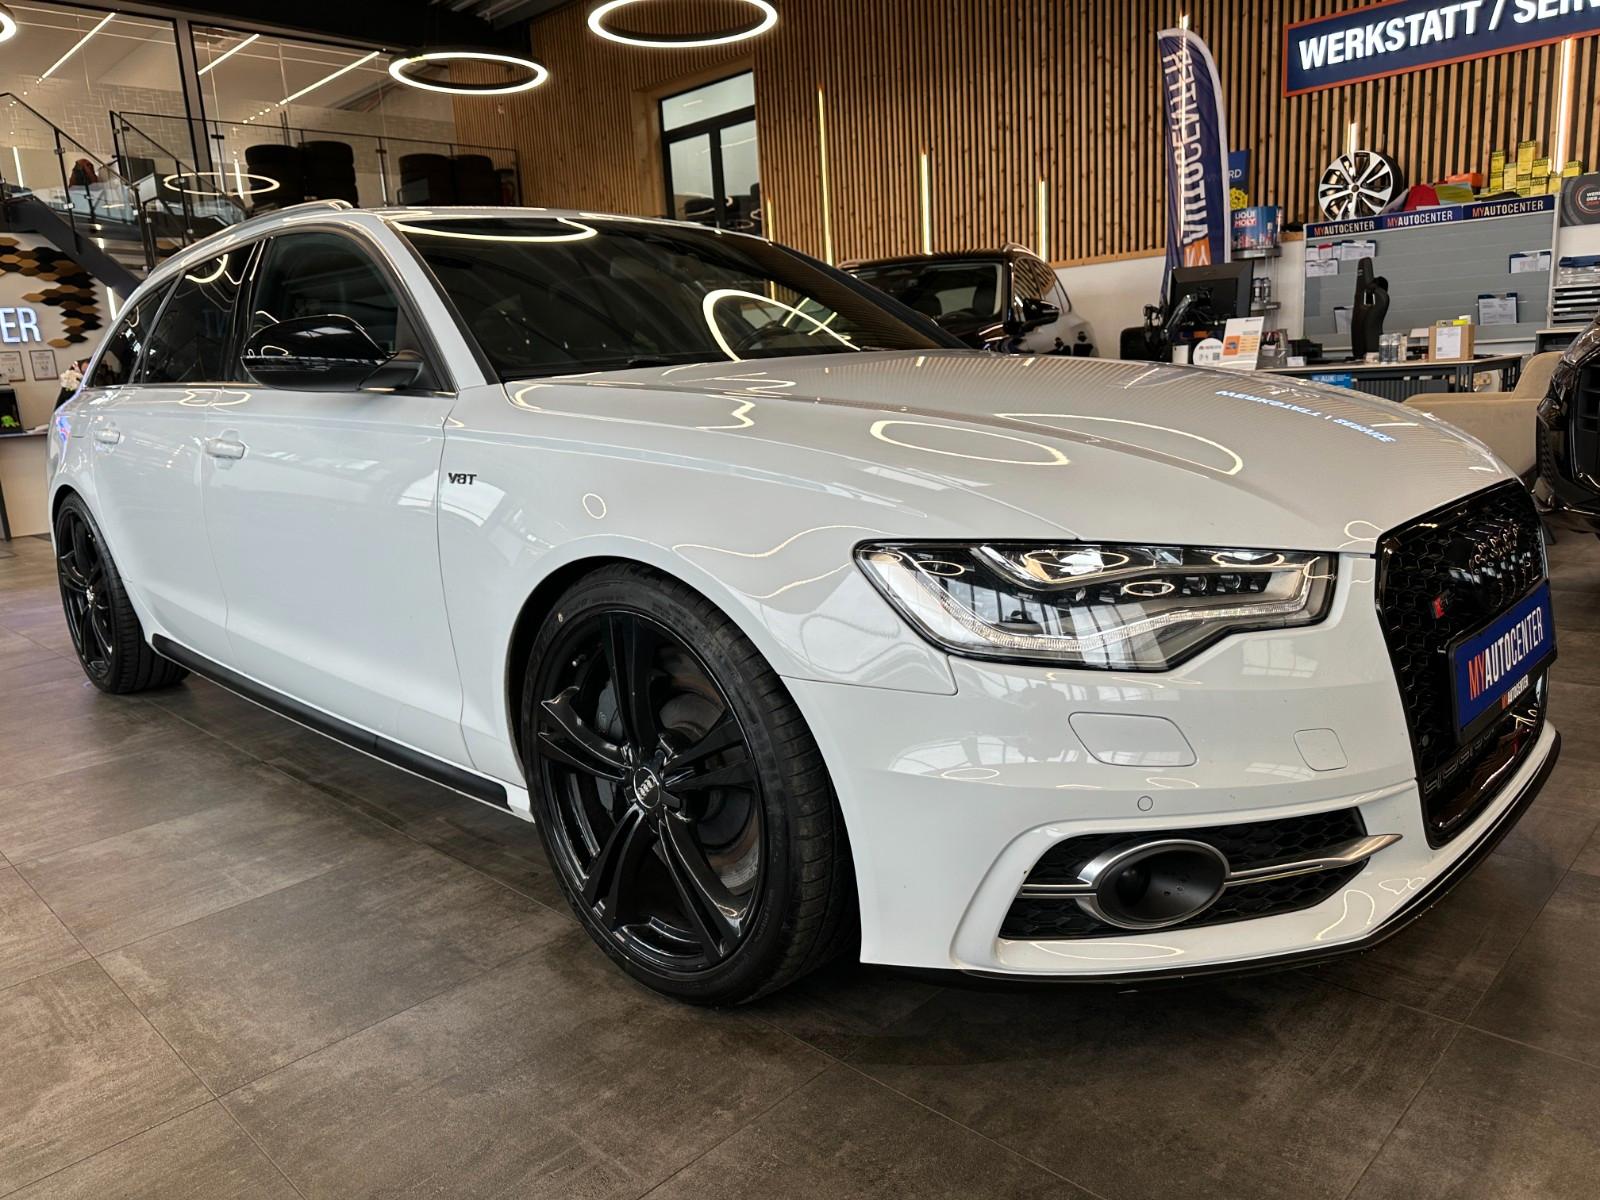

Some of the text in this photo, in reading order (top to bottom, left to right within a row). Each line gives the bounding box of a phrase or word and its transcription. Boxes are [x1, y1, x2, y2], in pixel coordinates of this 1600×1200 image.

[1299, 0, 1482, 71] WERKSTATT
[1472, 200, 1544, 218] MYAUTOCENTER
[1234, 217, 1257, 228] MOLY
[1387, 210, 1453, 228] MYAUTOCENTER
[1314, 221, 1375, 236] MYAUTOCENTER
[0, 307, 41, 343] ER
[448, 472, 477, 485] V8T
[1468, 606, 1544, 701] MYAUTOCENTER
